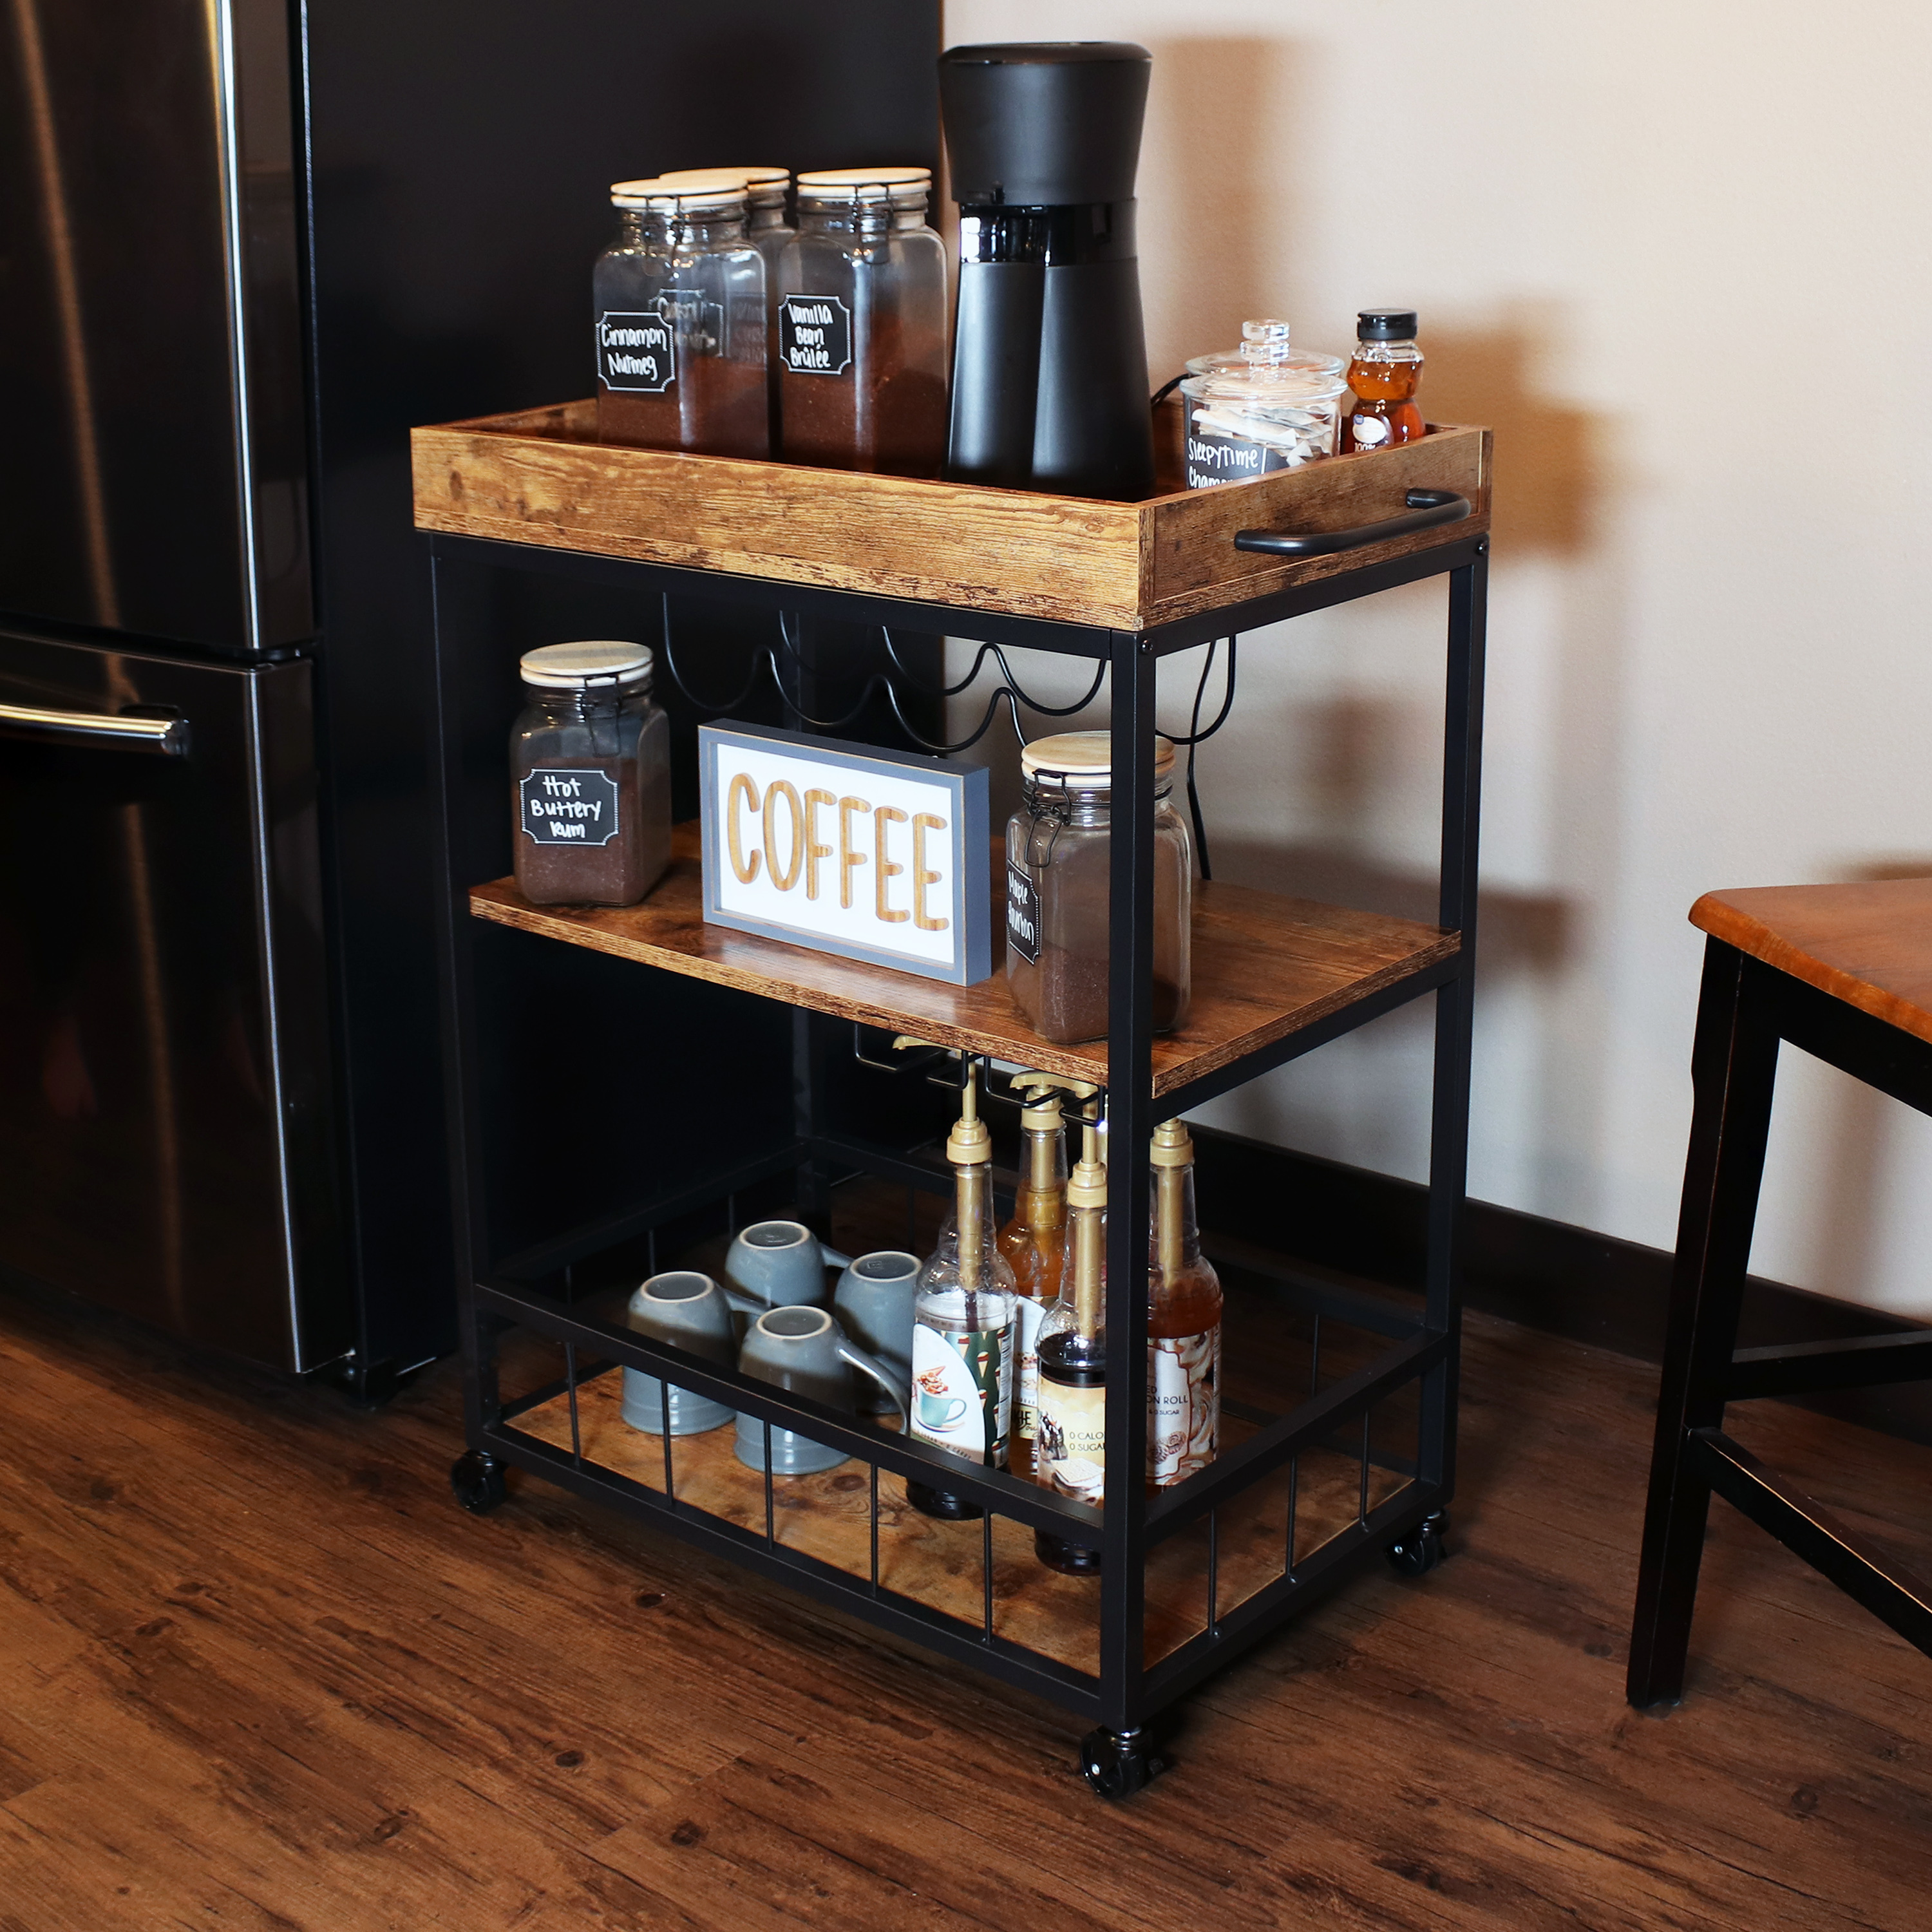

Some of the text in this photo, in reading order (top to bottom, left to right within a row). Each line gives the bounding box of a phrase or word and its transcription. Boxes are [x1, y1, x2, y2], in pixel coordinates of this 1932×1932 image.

[788, 303, 834, 325] Vanilla
[601, 323, 667, 352] Cinnamon
[795, 326, 824, 346] Bean
[607, 352, 658, 381] Nutmeg
[542, 775, 582, 797] Hot
[530, 799, 601, 821] Buttery
[549, 821, 585, 838] Rum
[728, 773, 949, 931] COFFEE
[1008, 871, 1028, 905] Maple
[1164, 1395, 1188, 1404] ROLL
